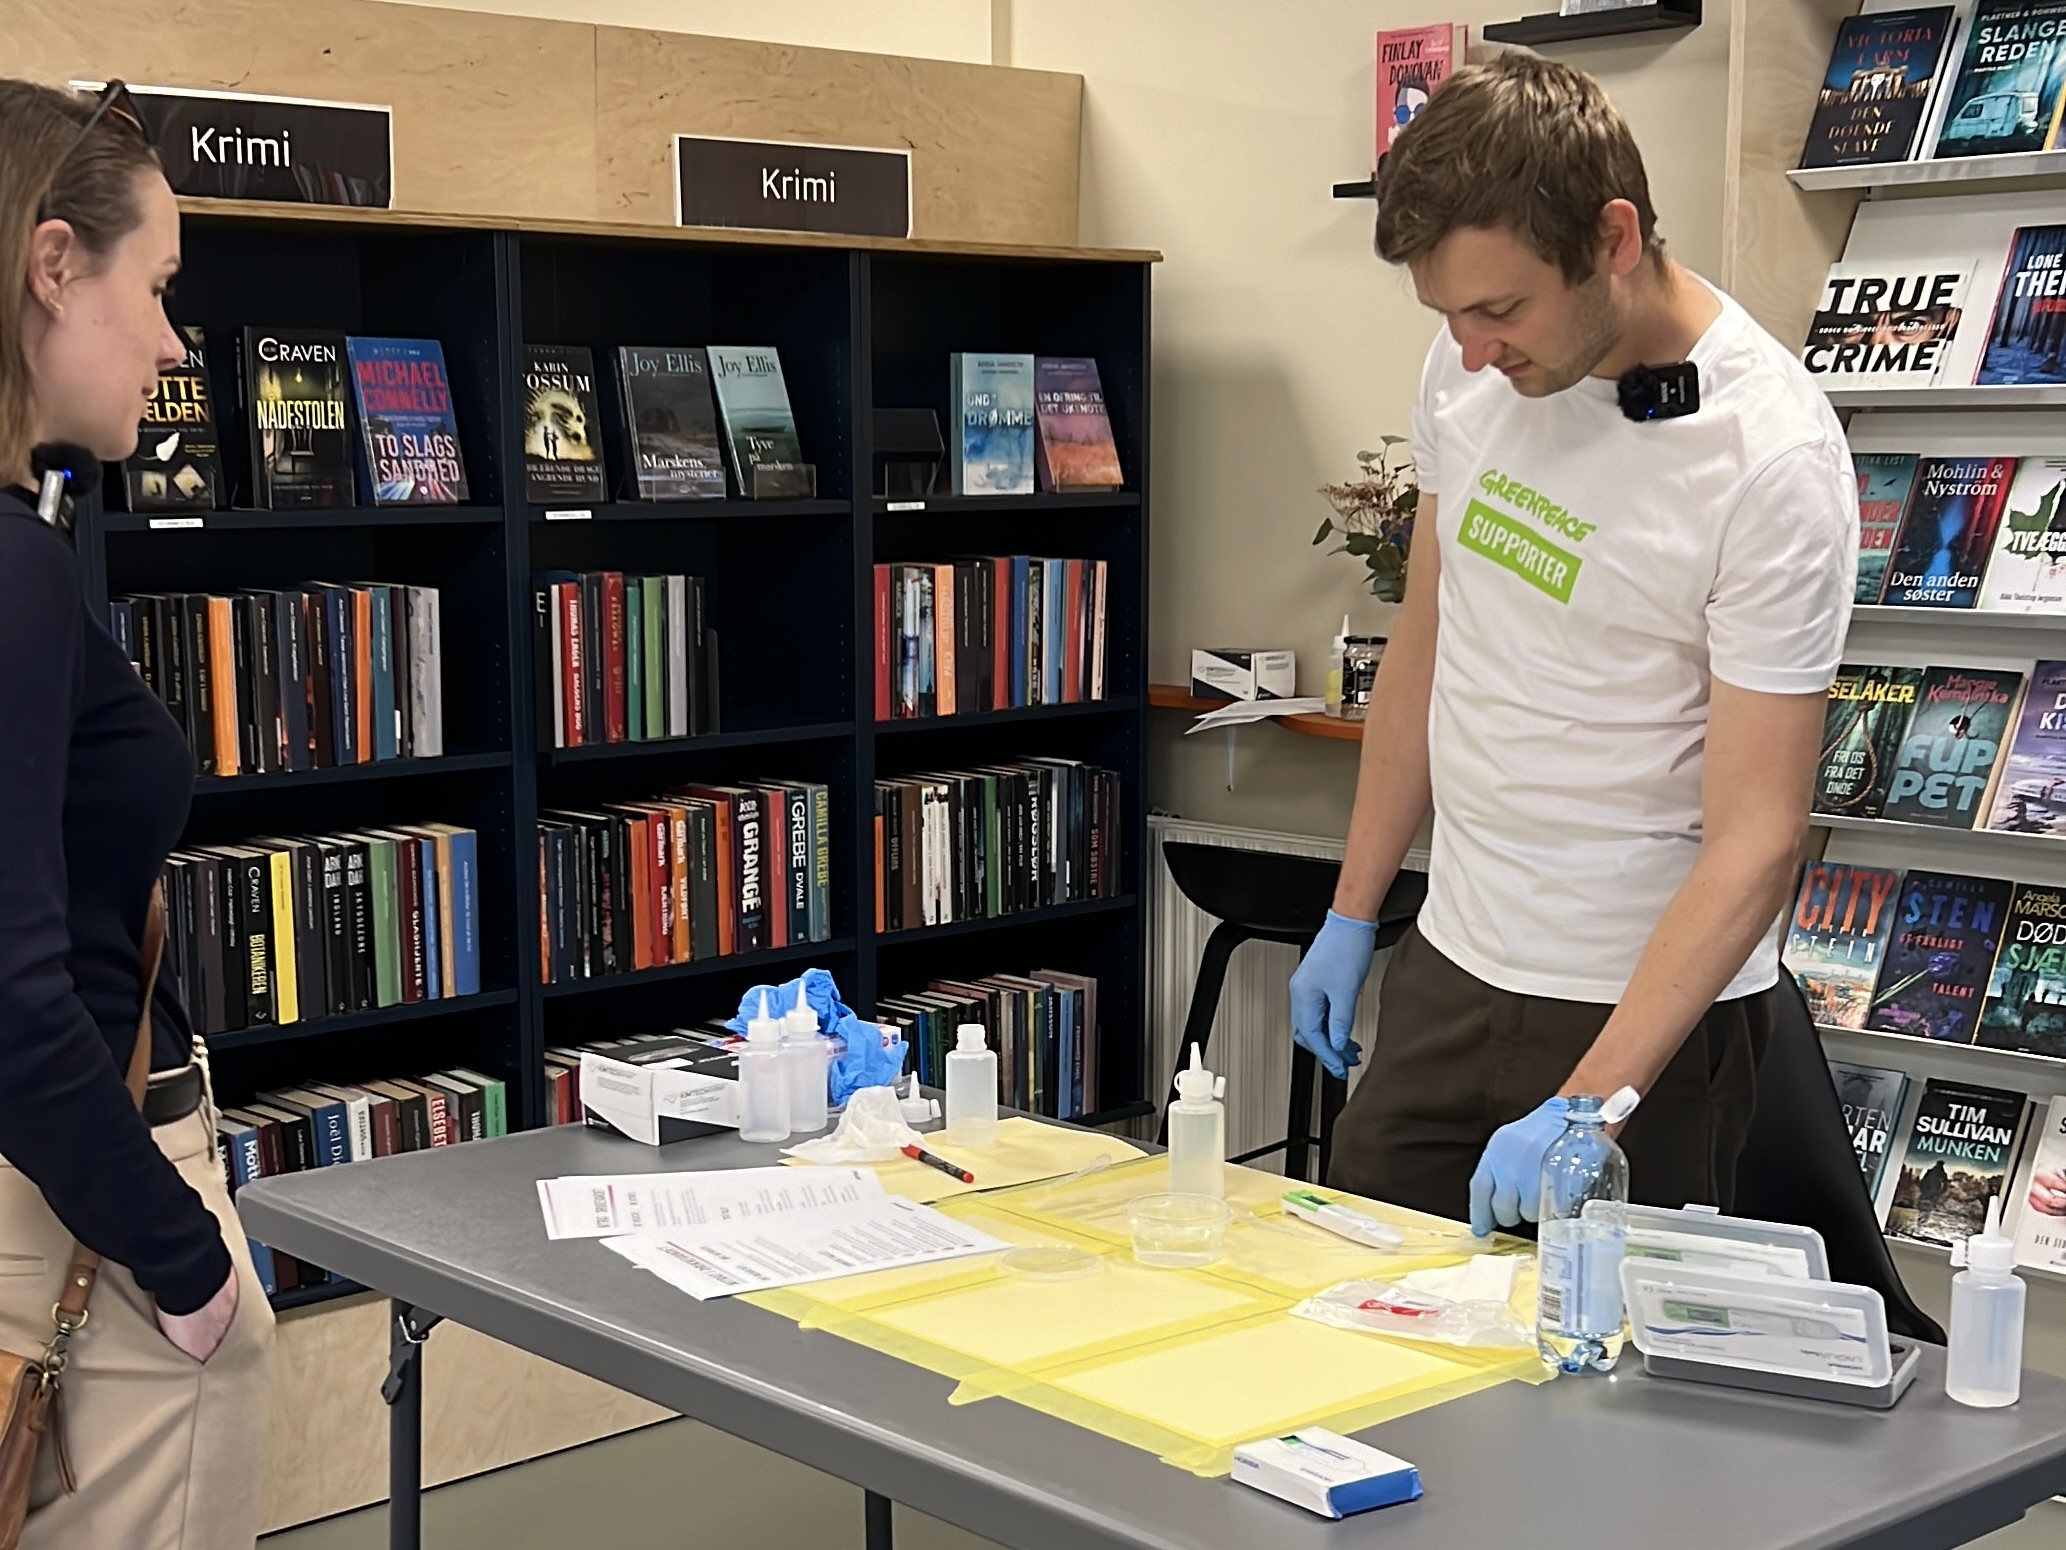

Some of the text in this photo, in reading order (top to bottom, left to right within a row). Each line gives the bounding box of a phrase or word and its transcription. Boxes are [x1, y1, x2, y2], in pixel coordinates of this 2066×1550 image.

[1382, 39, 1424, 63] FINLAY
[1980, 40, 2056, 63] REDEN
[1389, 60, 1444, 86] DONOVAN
[191, 126, 291, 167] Krimi
[761, 167, 837, 204] Krimi
[2027, 254, 2062, 269] LONE
[1828, 274, 1960, 315] TRUE
[258, 337, 336, 362] CRAVEN
[1804, 341, 1940, 373] CRIME
[357, 360, 446, 387] MICHAEL
[534, 362, 569, 373] KARIN
[630, 352, 702, 378] Joy Ellis
[718, 355, 776, 378] Joy Ellis
[523, 373, 591, 393] OSSUM
[363, 388, 448, 412] CONNELLY
[967, 408, 1032, 429] DRØMME
[375, 434, 456, 458] TO SLAGS
[745, 436, 774, 453] Tyve
[380, 459, 460, 482] SANDHED
[643, 454, 703, 470] Marskens
[1927, 464, 2004, 479] Mohlin &
[1924, 480, 1997, 498] Nyström
[1479, 469, 1597, 542] GREENPEACE
[1468, 514, 1568, 589] SUPPORTER
[1891, 571, 1978, 588] Den anden
[1904, 588, 1955, 601] søster
[1827, 680, 1915, 703] SELÅKER
[1851, 751, 1865, 764] OS
[1903, 735, 1997, 773] FUP
[1824, 765, 1865, 780] FRA DET
[1826, 782, 1853, 795] ONDE
[1888, 770, 1986, 811] PET
[815, 791, 829, 888] CAMILLA GREBE
[792, 802, 806, 909] GREBE DVALE
[1797, 867, 1896, 934] CITY
[2023, 889, 2060, 906] Angela
[1904, 892, 1996, 933] STEN
[248, 866, 267, 995] CRAVEN BOTANIKEREN
[1790, 933, 1876, 963] STEIN
[1932, 983, 1975, 999] TALENT
[1842, 1103, 1892, 1132] RTEN
[1948, 1103, 1987, 1124] TIM
[328, 1114, 342, 1142] Joël
[1916, 1116, 2012, 1146] SULLIVAN
[1917, 1136, 2001, 1162] MUNKEN
